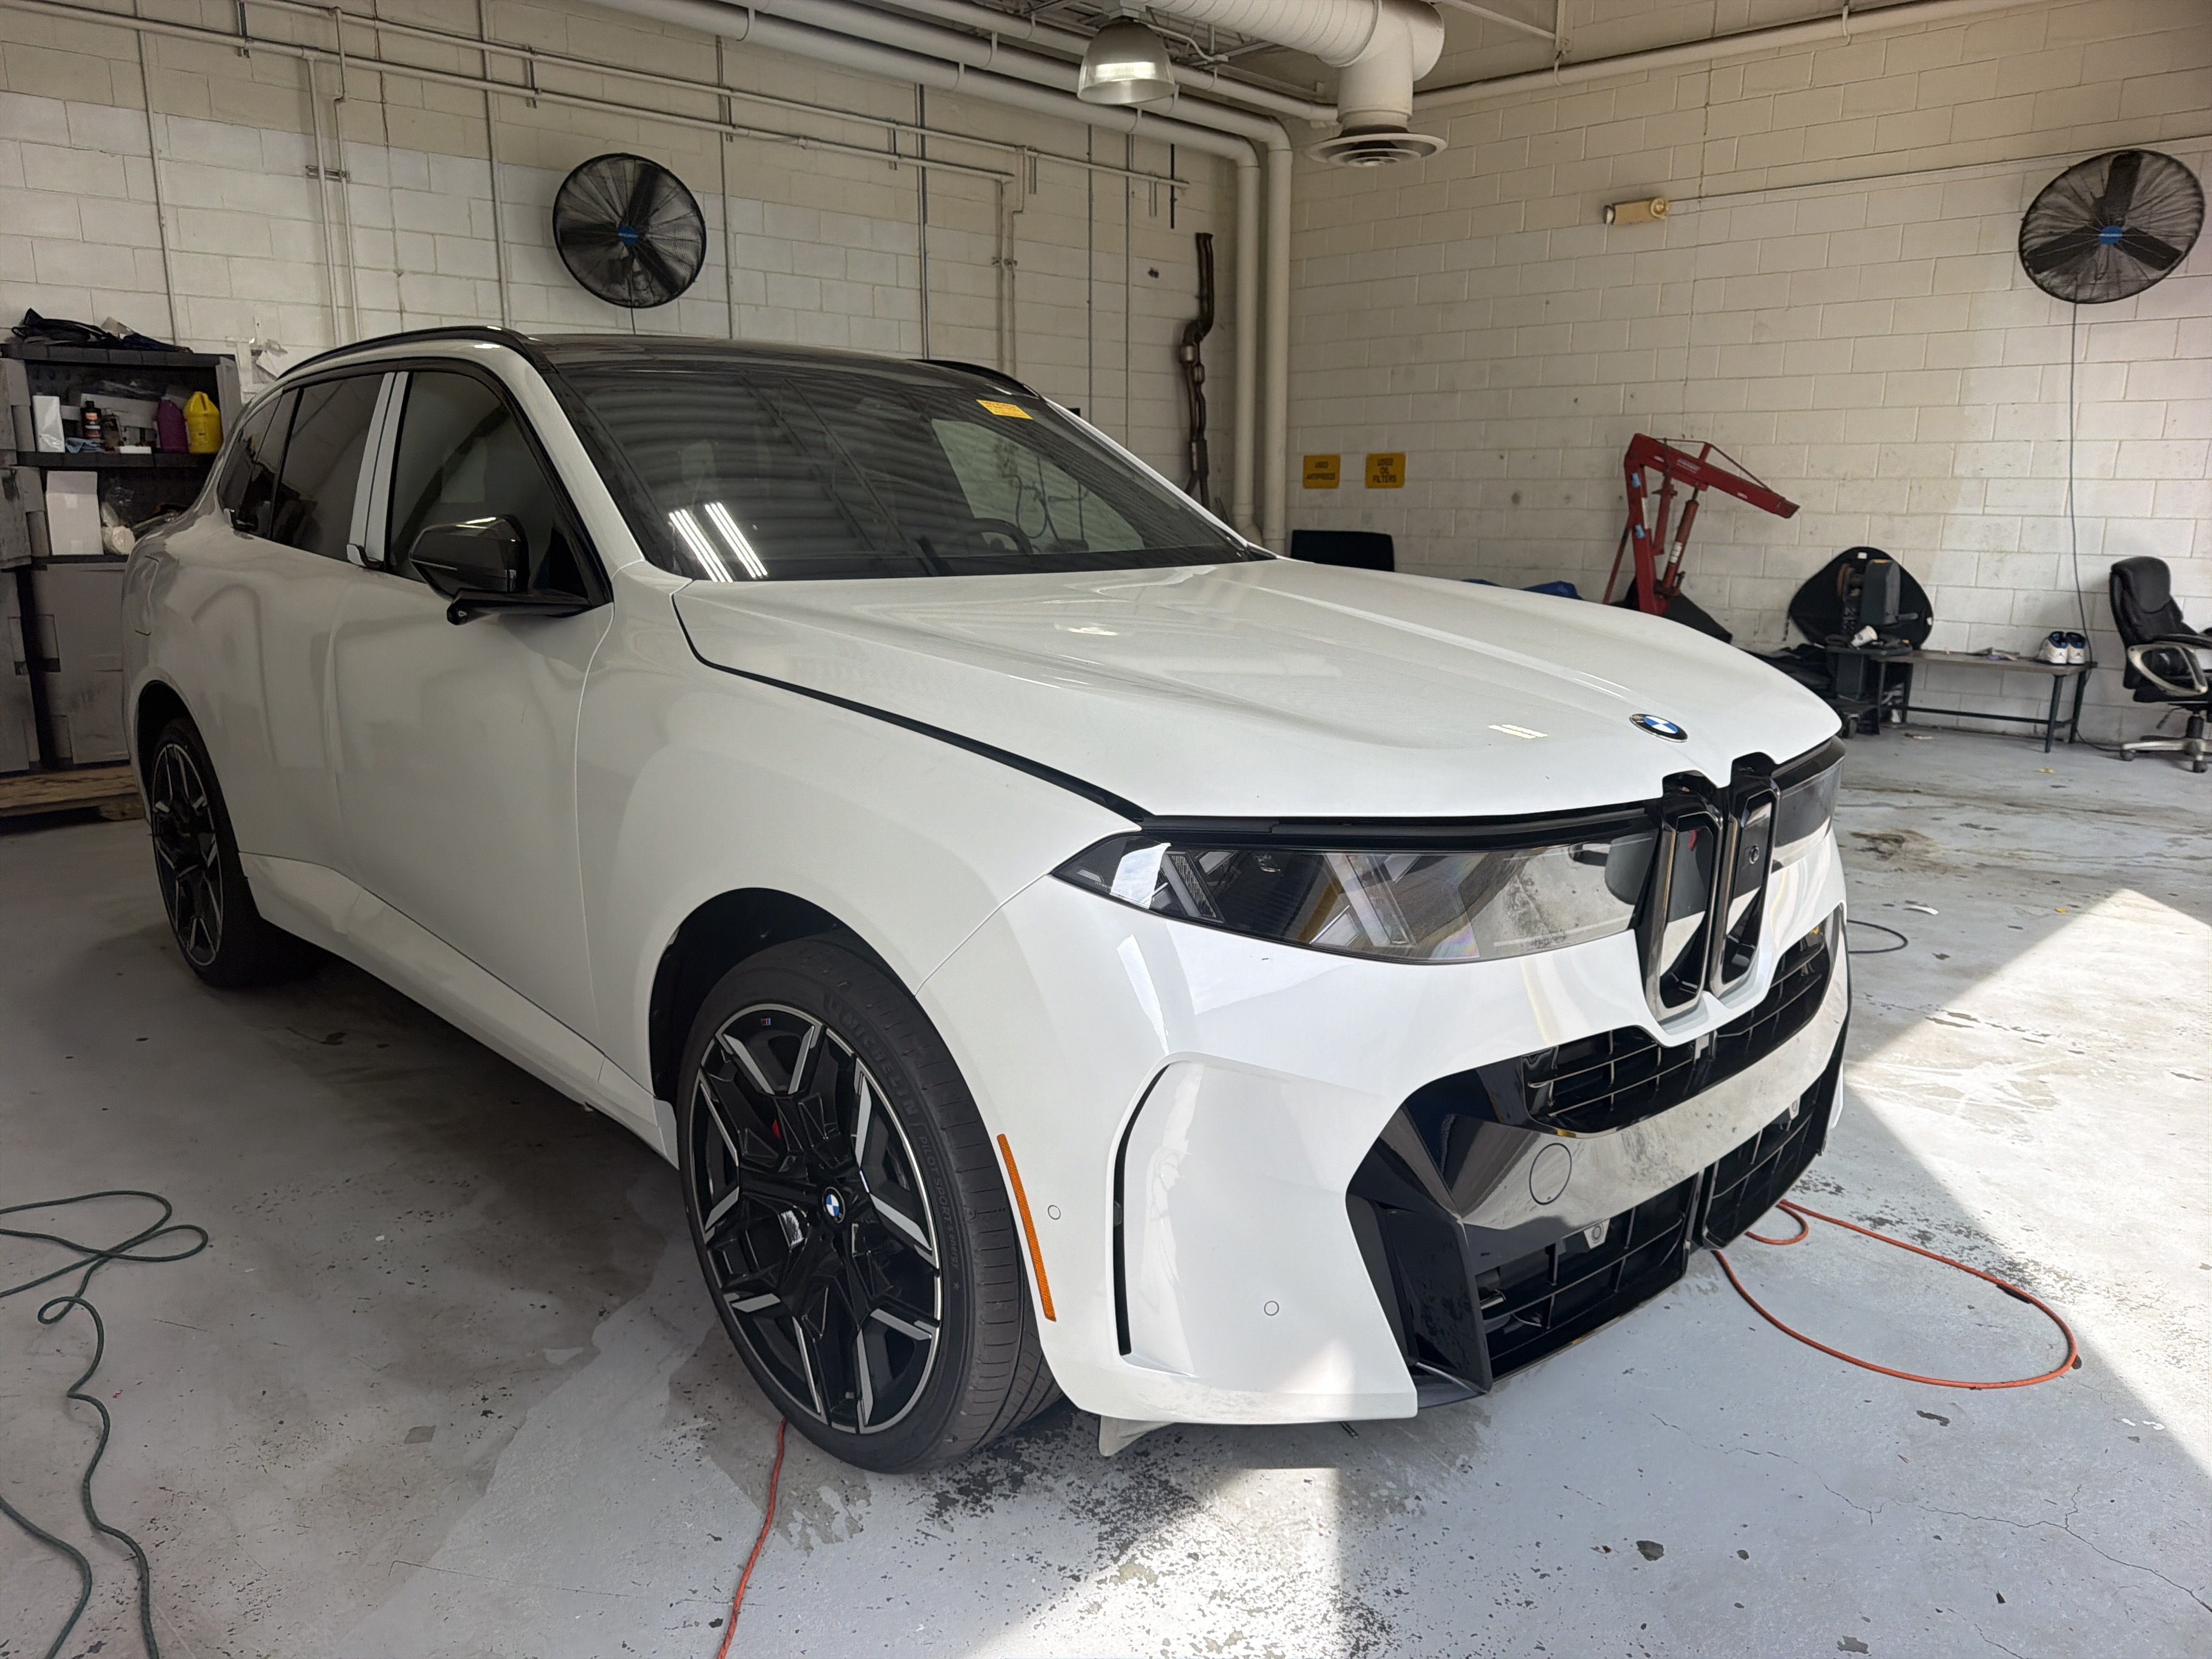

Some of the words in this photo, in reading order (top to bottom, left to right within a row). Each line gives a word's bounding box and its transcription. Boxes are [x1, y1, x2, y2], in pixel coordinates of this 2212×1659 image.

[840, 1012, 917, 1115] MICHELIN
[919, 1136, 939, 1174] PILOT
[934, 1177, 952, 1224] SPORT
[949, 1234, 959, 1268] energy
